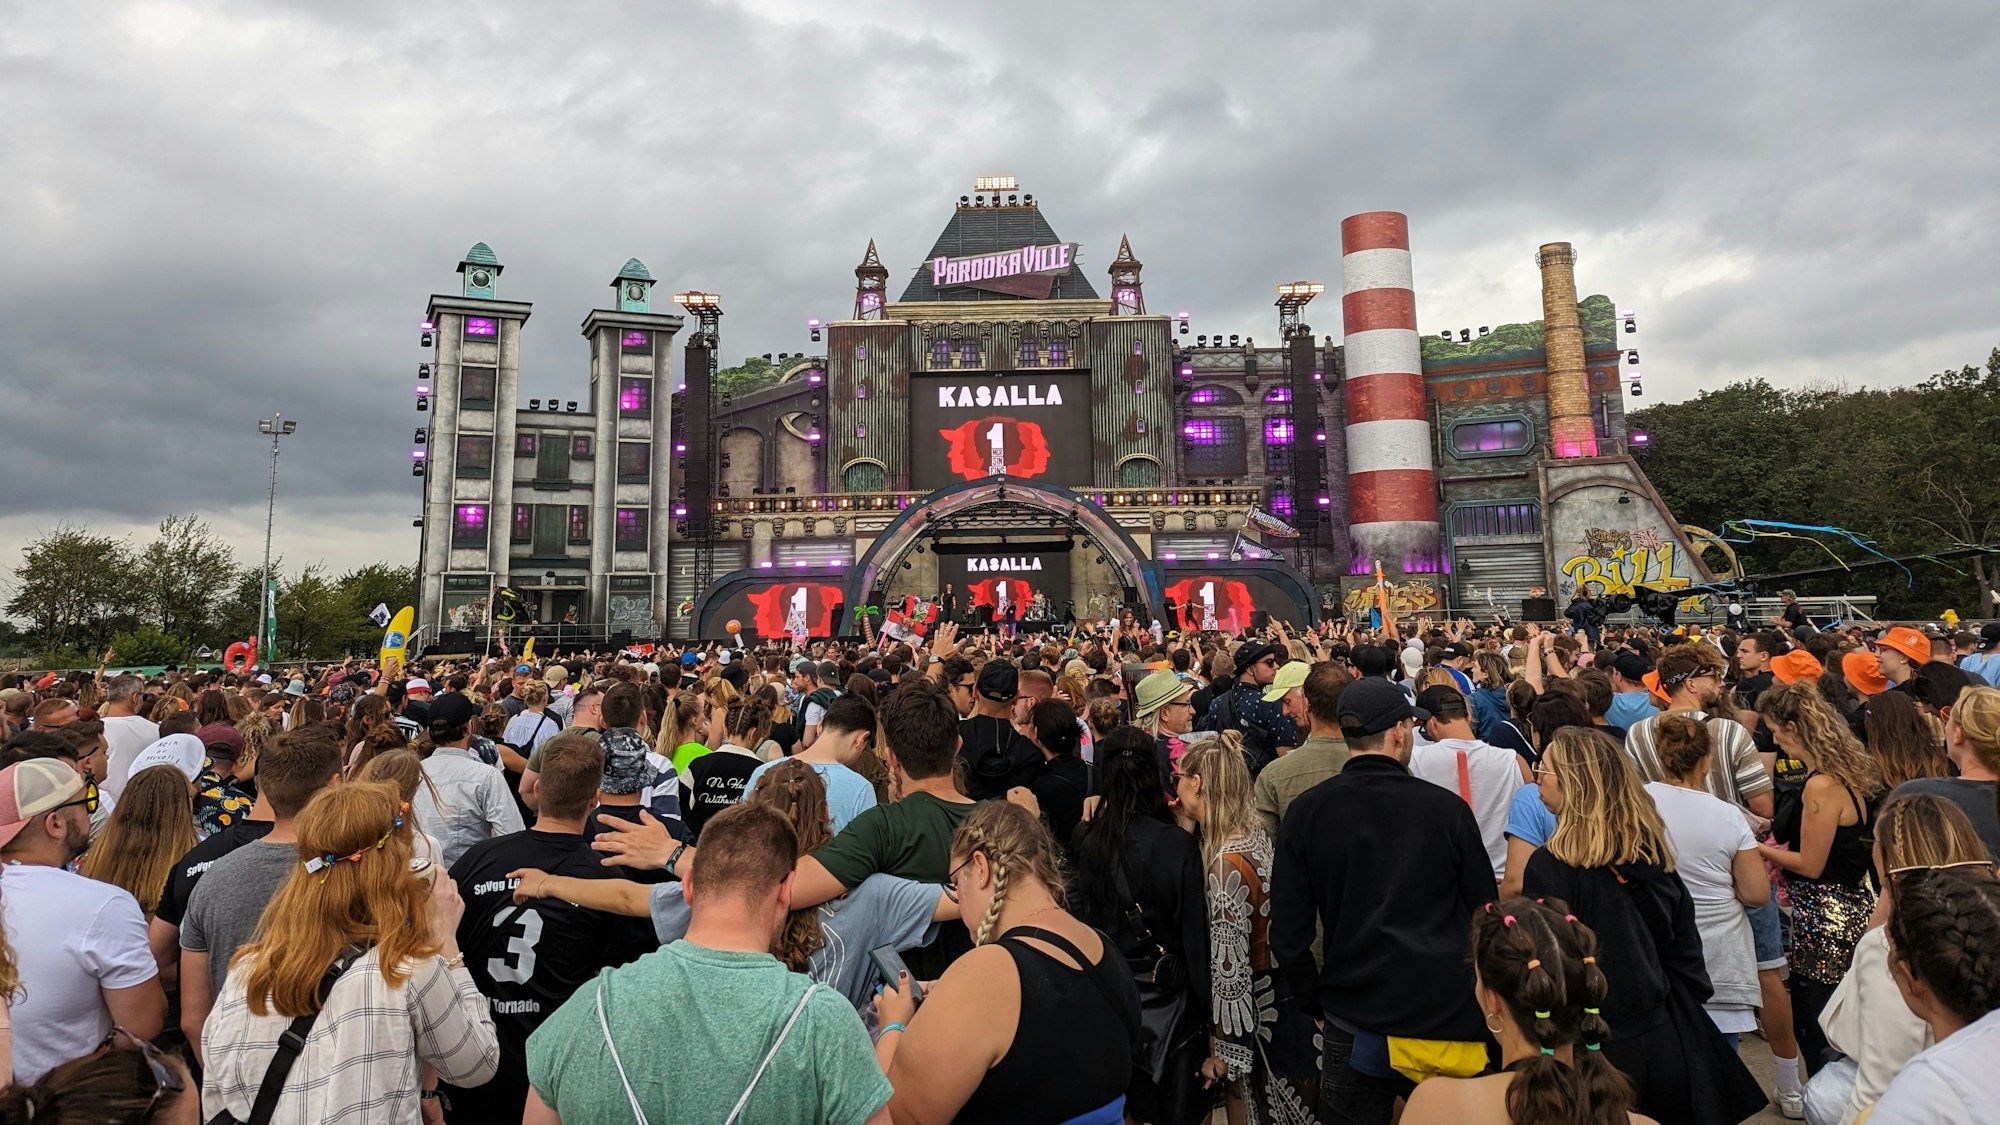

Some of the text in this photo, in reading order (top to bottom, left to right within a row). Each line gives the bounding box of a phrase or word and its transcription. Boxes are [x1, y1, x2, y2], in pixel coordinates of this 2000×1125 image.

[939, 384, 1063, 408] KASALLA
[986, 422, 1004, 449] 1
[967, 557, 1042, 571] KASALLA
[1199, 582, 1215, 604] 1
[474, 879, 505, 896] SpVgg
[487, 906, 544, 985] 3
[492, 998, 541, 1014] Tornado
